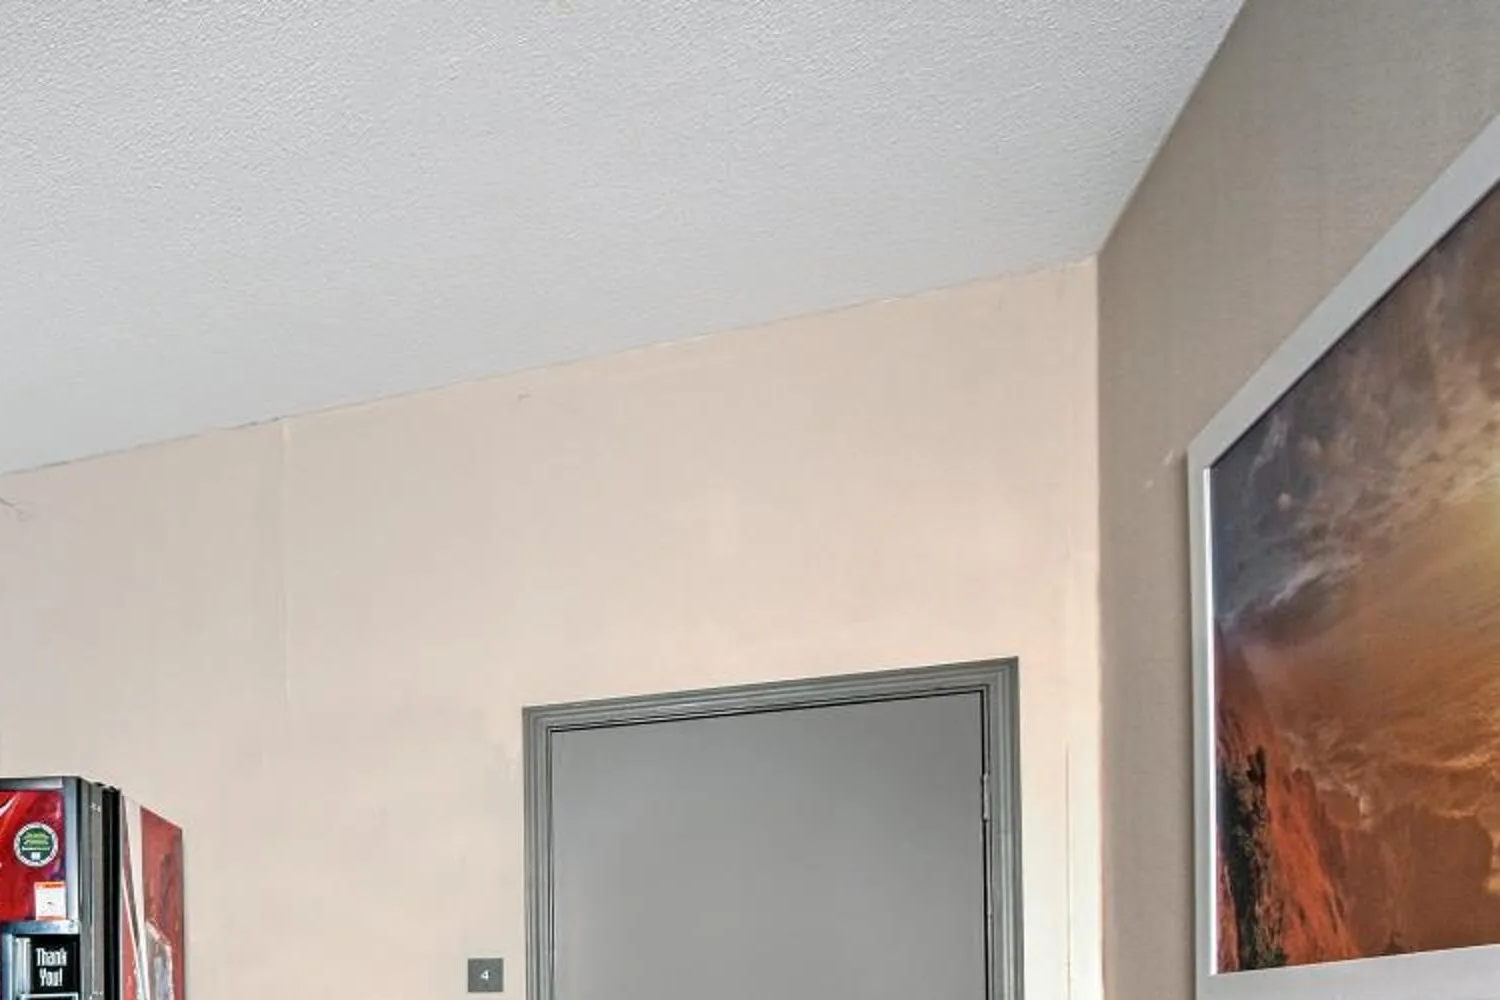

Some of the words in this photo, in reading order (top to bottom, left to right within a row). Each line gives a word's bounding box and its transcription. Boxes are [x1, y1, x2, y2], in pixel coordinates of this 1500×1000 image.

[36, 948, 67, 966] Thank
[39, 968, 63, 987] You!
[480, 969, 489, 981] 4
